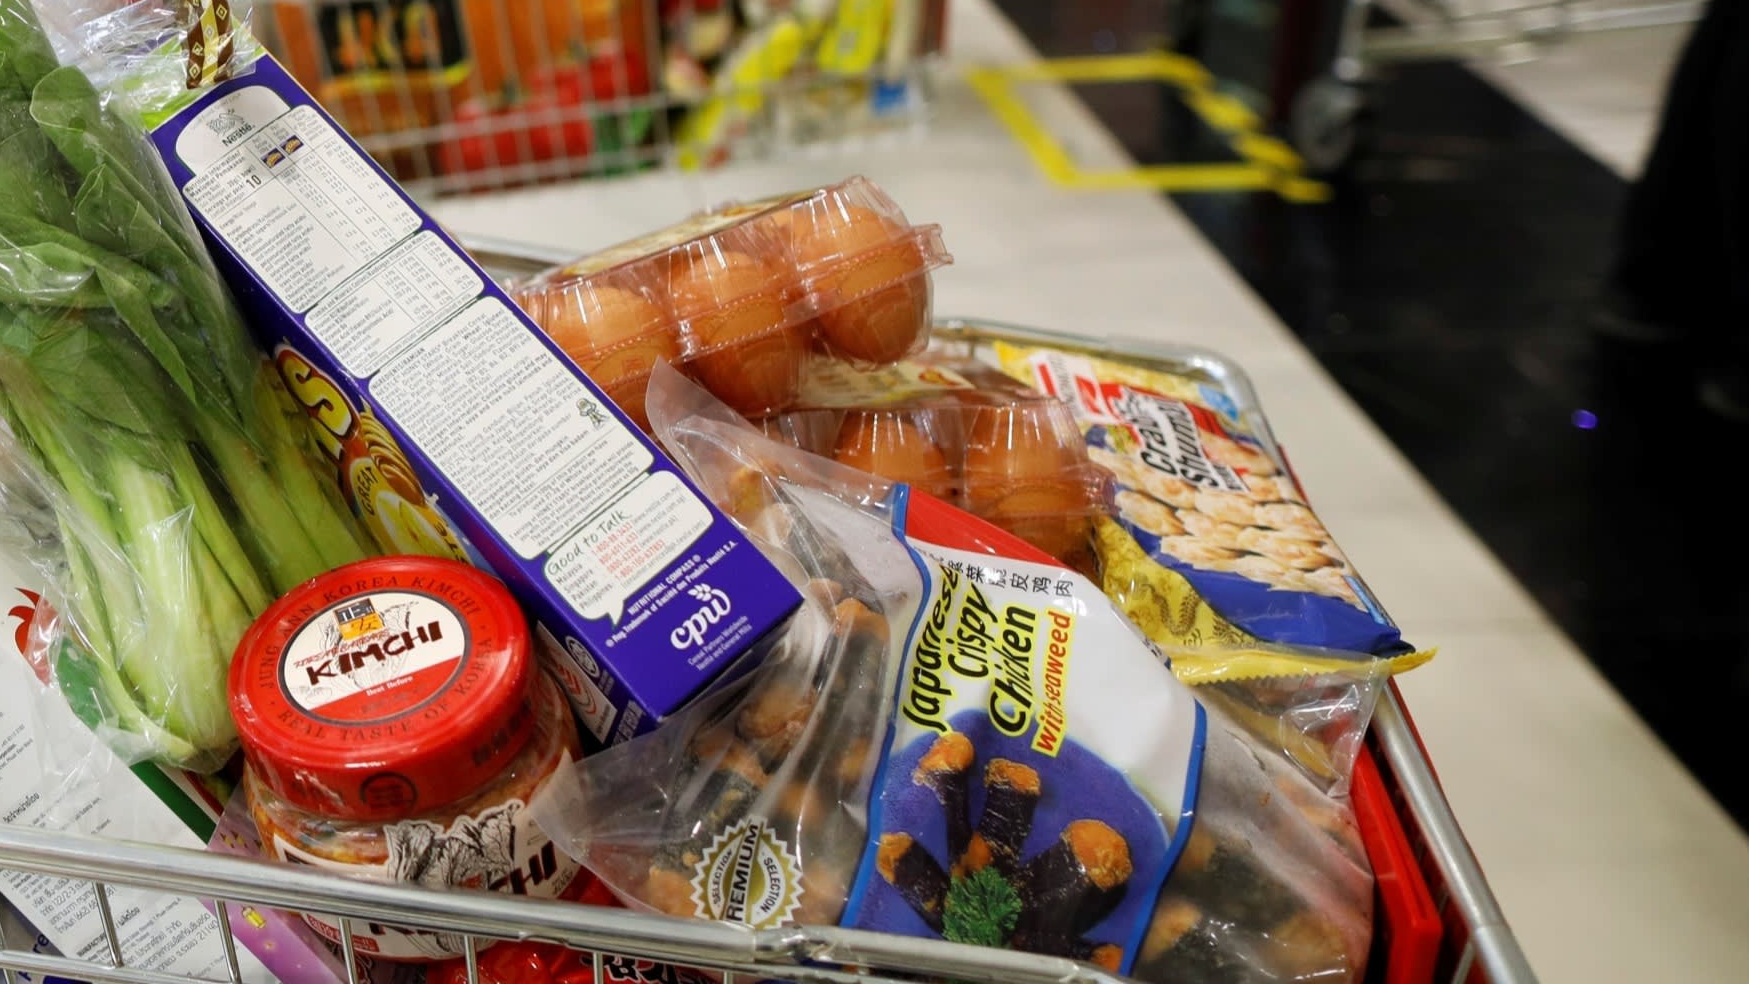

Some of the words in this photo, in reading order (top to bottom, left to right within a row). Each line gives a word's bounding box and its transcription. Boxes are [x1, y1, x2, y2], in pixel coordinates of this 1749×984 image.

[245, 174, 261, 188] 10
[523, 360, 535, 371] and
[534, 352, 547, 362] may
[478, 403, 490, 414] and
[362, 466, 380, 516] GREAT
[547, 543, 582, 575] Good
[582, 533, 598, 547] to
[596, 510, 627, 533] Talk
[323, 575, 399, 602] KOREA
[412, 575, 481, 615] KIMCHI
[628, 583, 666, 614] NUTRITIONAL
[665, 559, 694, 584] COMPASS
[649, 603, 657, 611] of
[675, 580, 687, 590] des
[671, 589, 731, 649] cpw
[945, 582, 998, 678] Crispy
[306, 621, 444, 686] KIMCHI
[903, 565, 959, 733] Japanese
[990, 605, 1037, 734] Chicken
[1043, 610, 1071, 706] seaweed
[277, 709, 327, 740] REAL
[338, 722, 415, 741] TASTE
[455, 637, 494, 696] KOREA
[366, 684, 386, 698] Best
[387, 675, 414, 690] Before
[711, 850, 732, 906] SELECTION
[726, 824, 759, 922] REMIUM
[760, 856, 781, 913] SELECTION
